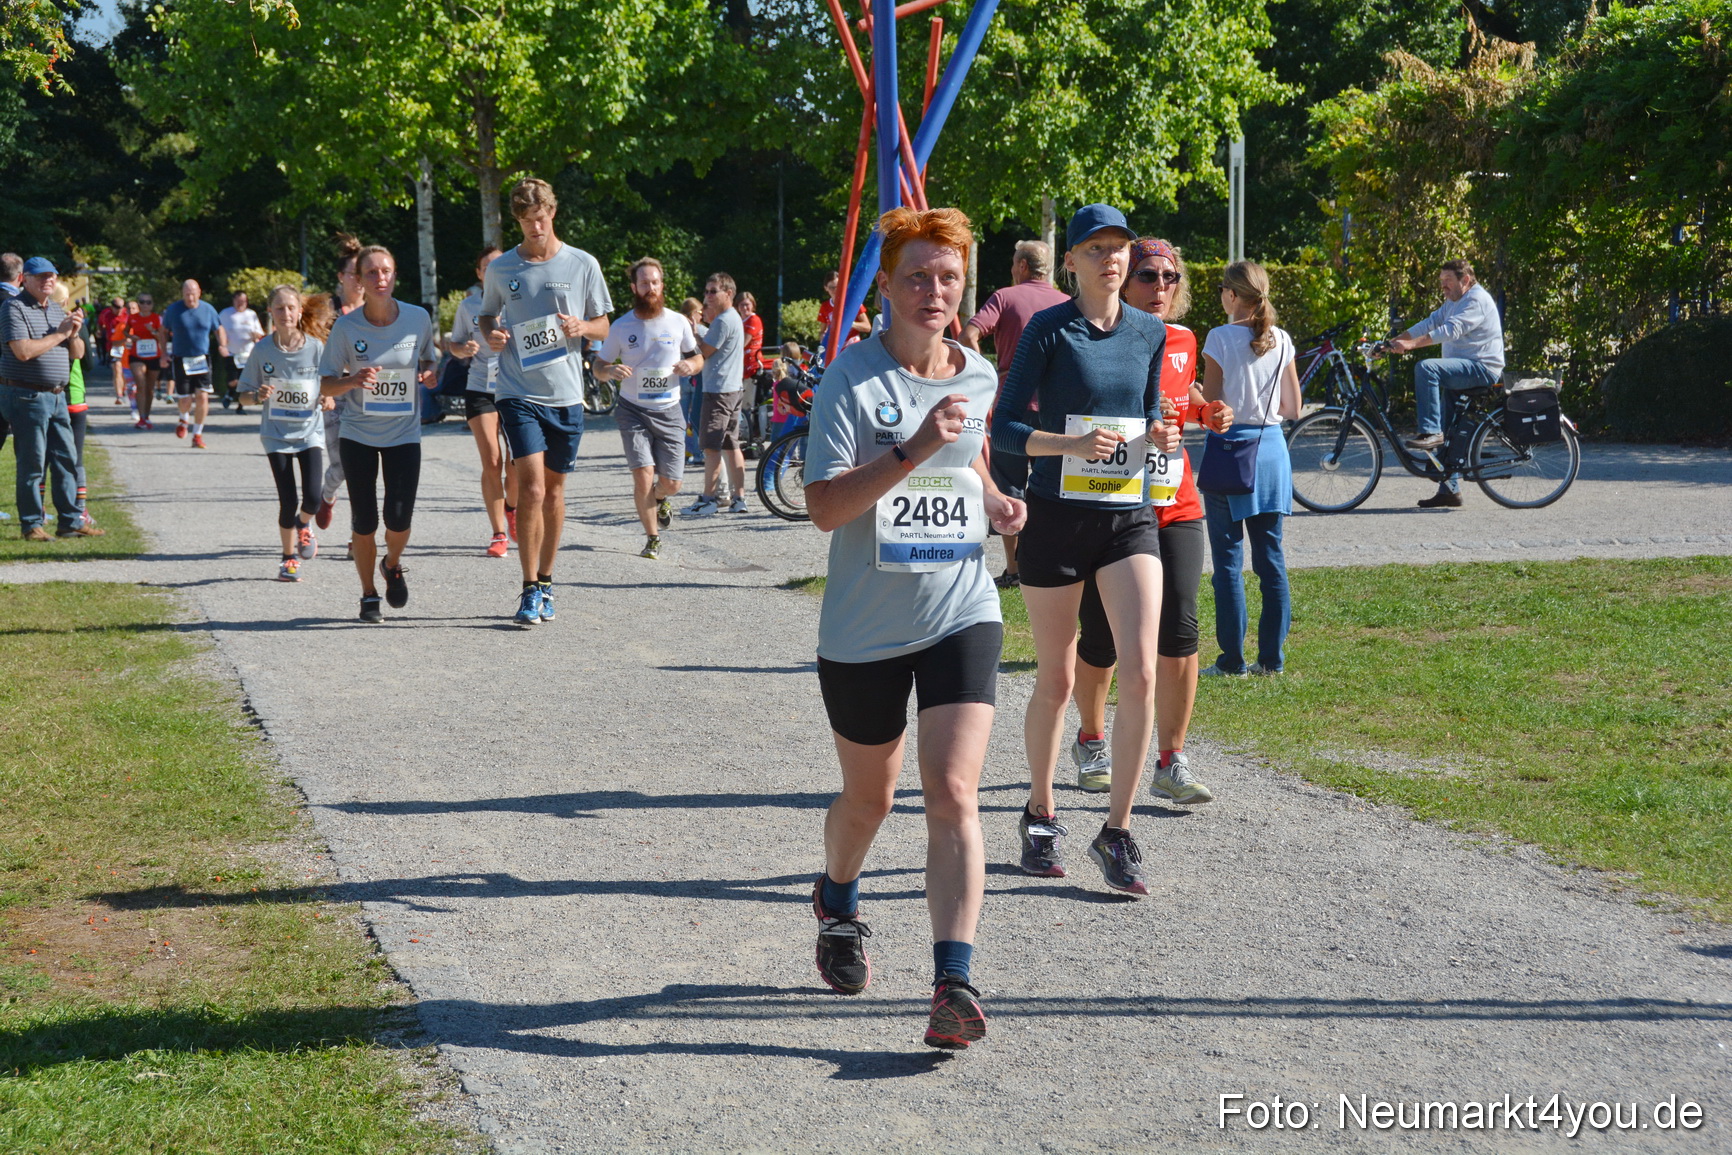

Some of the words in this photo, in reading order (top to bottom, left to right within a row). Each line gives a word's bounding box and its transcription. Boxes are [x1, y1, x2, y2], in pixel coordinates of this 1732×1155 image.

[523, 329, 557, 350] 3033
[371, 382, 407, 396] 3079
[642, 377, 668, 388] 2632
[277, 391, 309, 404] 2068
[875, 432, 905, 440] PARTL
[908, 477, 952, 487] BOCK
[1089, 480, 1122, 492] Sophie
[893, 496, 968, 527] 2484
[910, 547, 954, 560] Andrea
